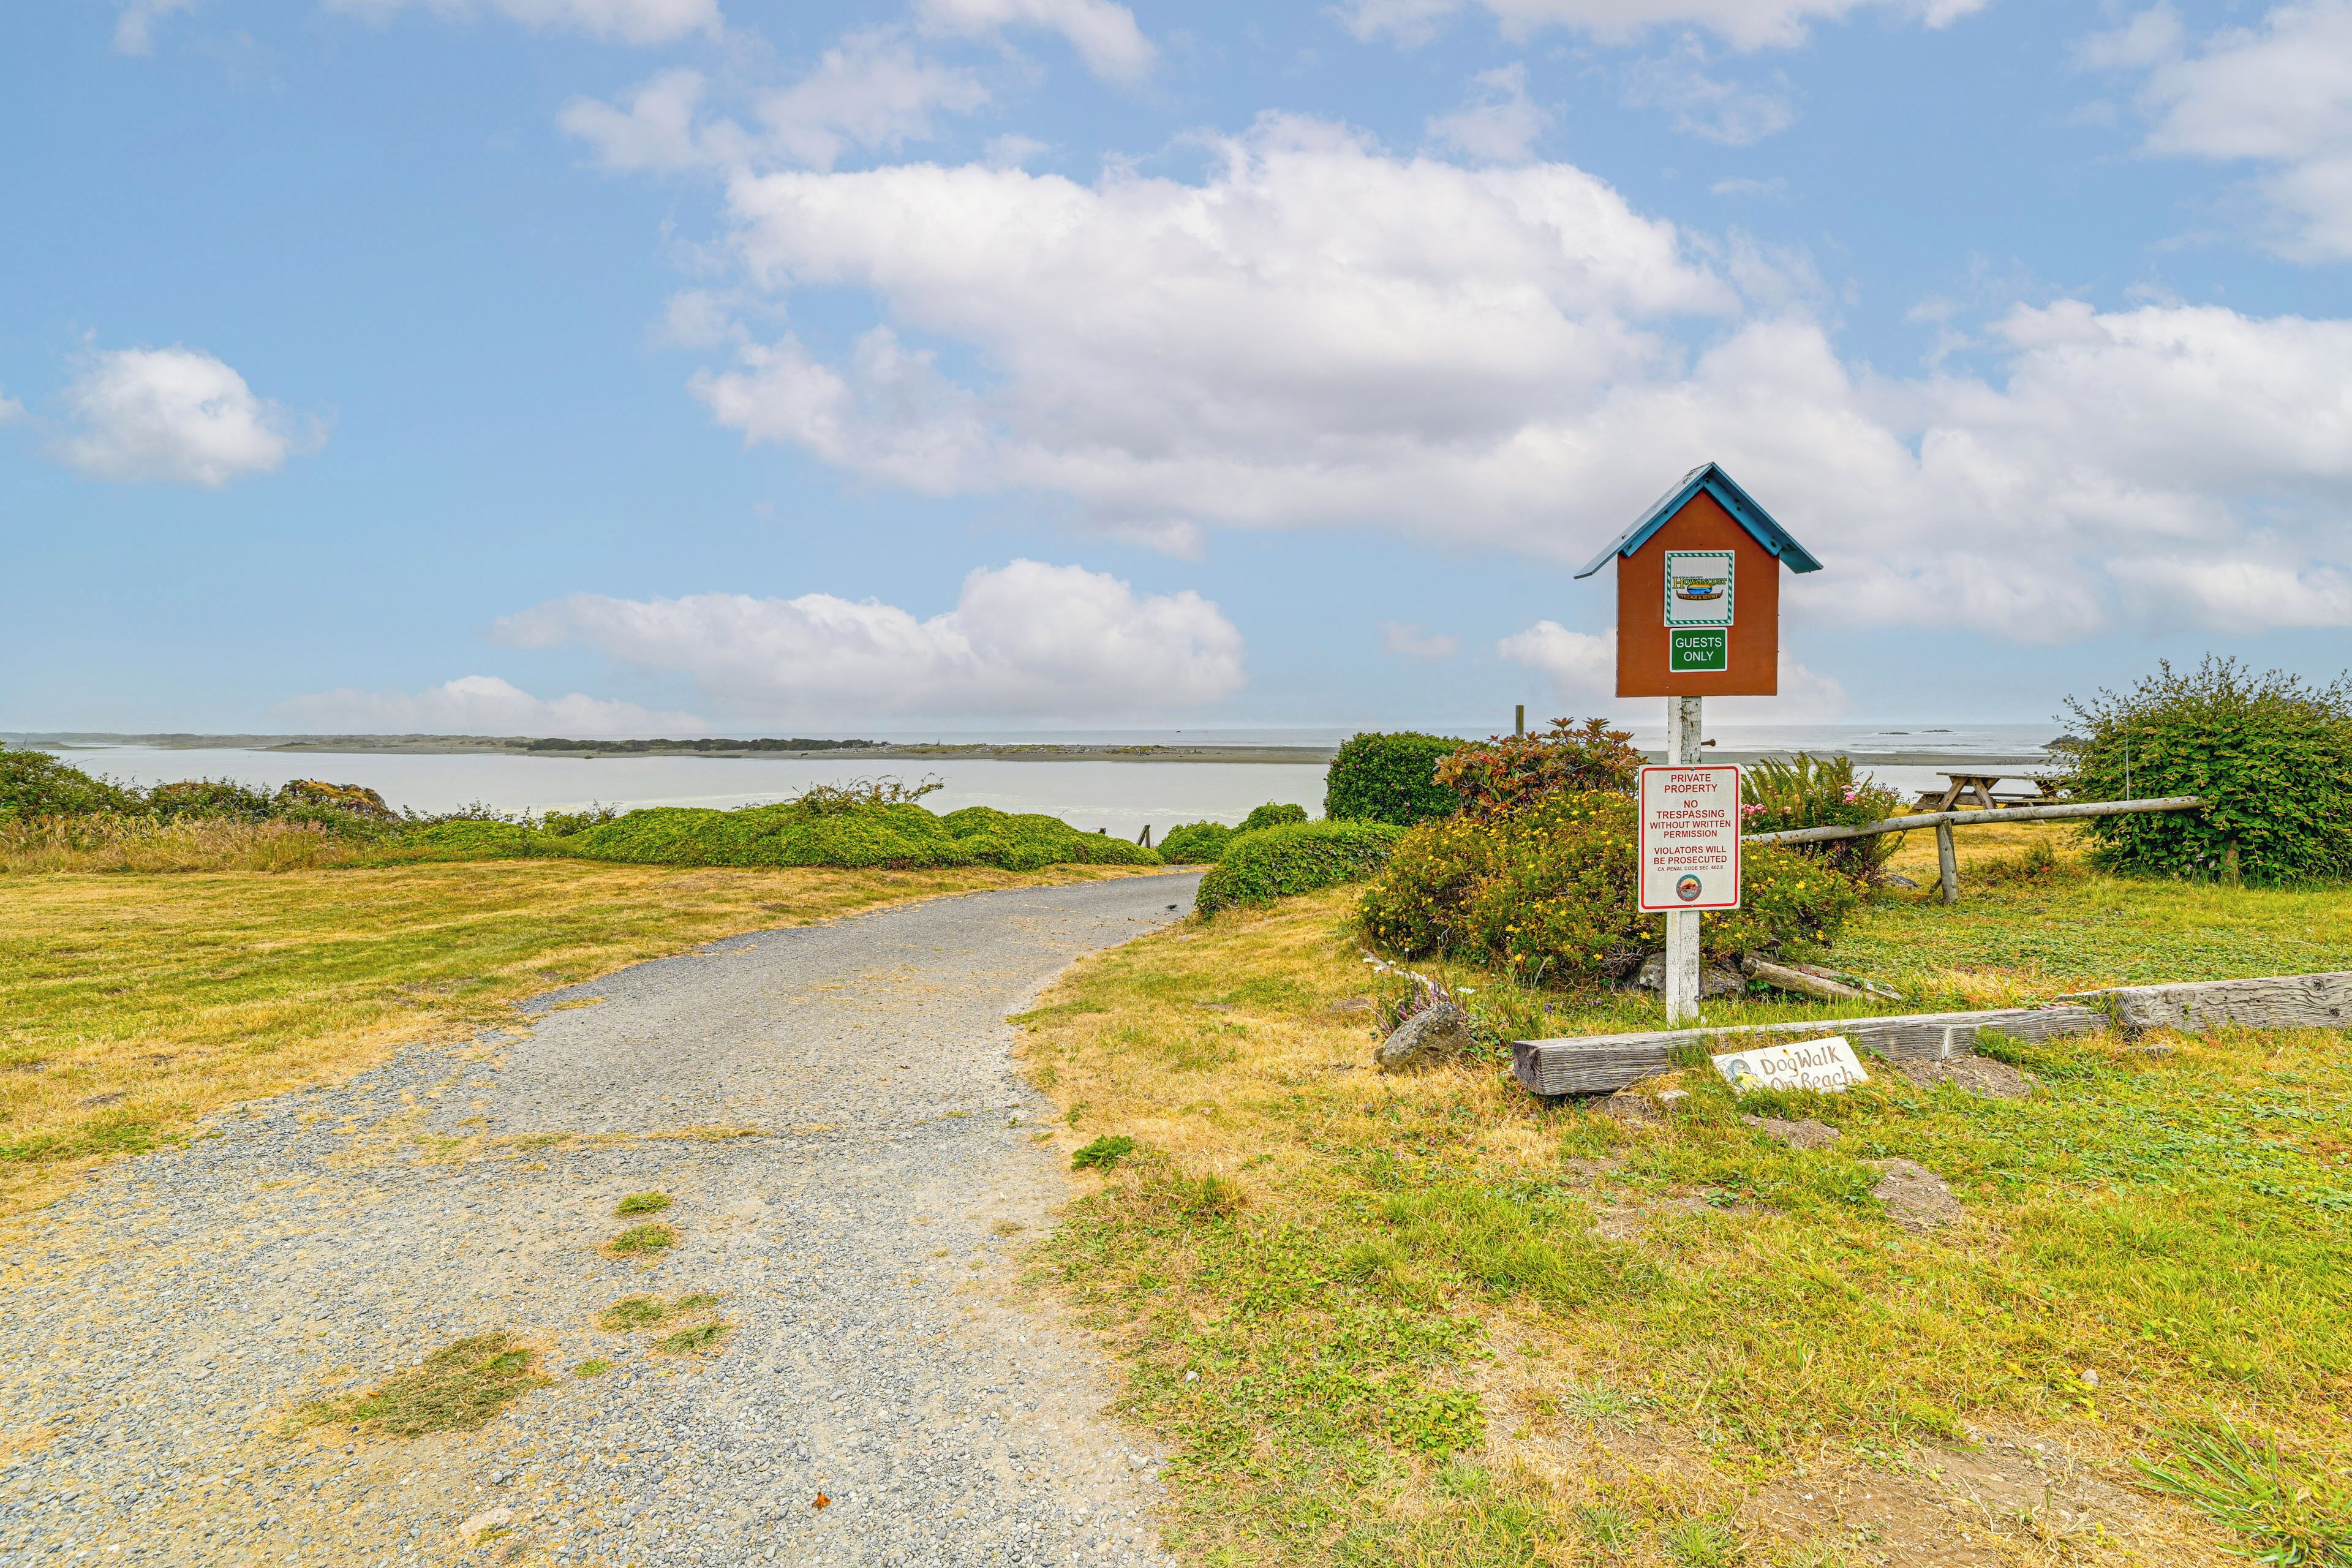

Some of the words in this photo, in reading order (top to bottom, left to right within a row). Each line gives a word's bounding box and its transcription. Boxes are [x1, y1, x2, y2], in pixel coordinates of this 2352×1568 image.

[1672, 576, 1727, 589] HOWONQUET
[1675, 637, 1722, 648] GUESTS
[1684, 651, 1714, 662] ONLY
[1671, 774, 1711, 783] PRIVATE
[1664, 784, 1717, 793] PROPERTY
[1656, 809, 1725, 819] TRESPASSING
[1692, 820, 1731, 828] WRITTEN
[1654, 846, 1703, 854] VIOLATORS
[1668, 855, 1727, 864] PROSECUTED
[1771, 1077, 1794, 1091] On
[1801, 1066, 1854, 1091] Beach
